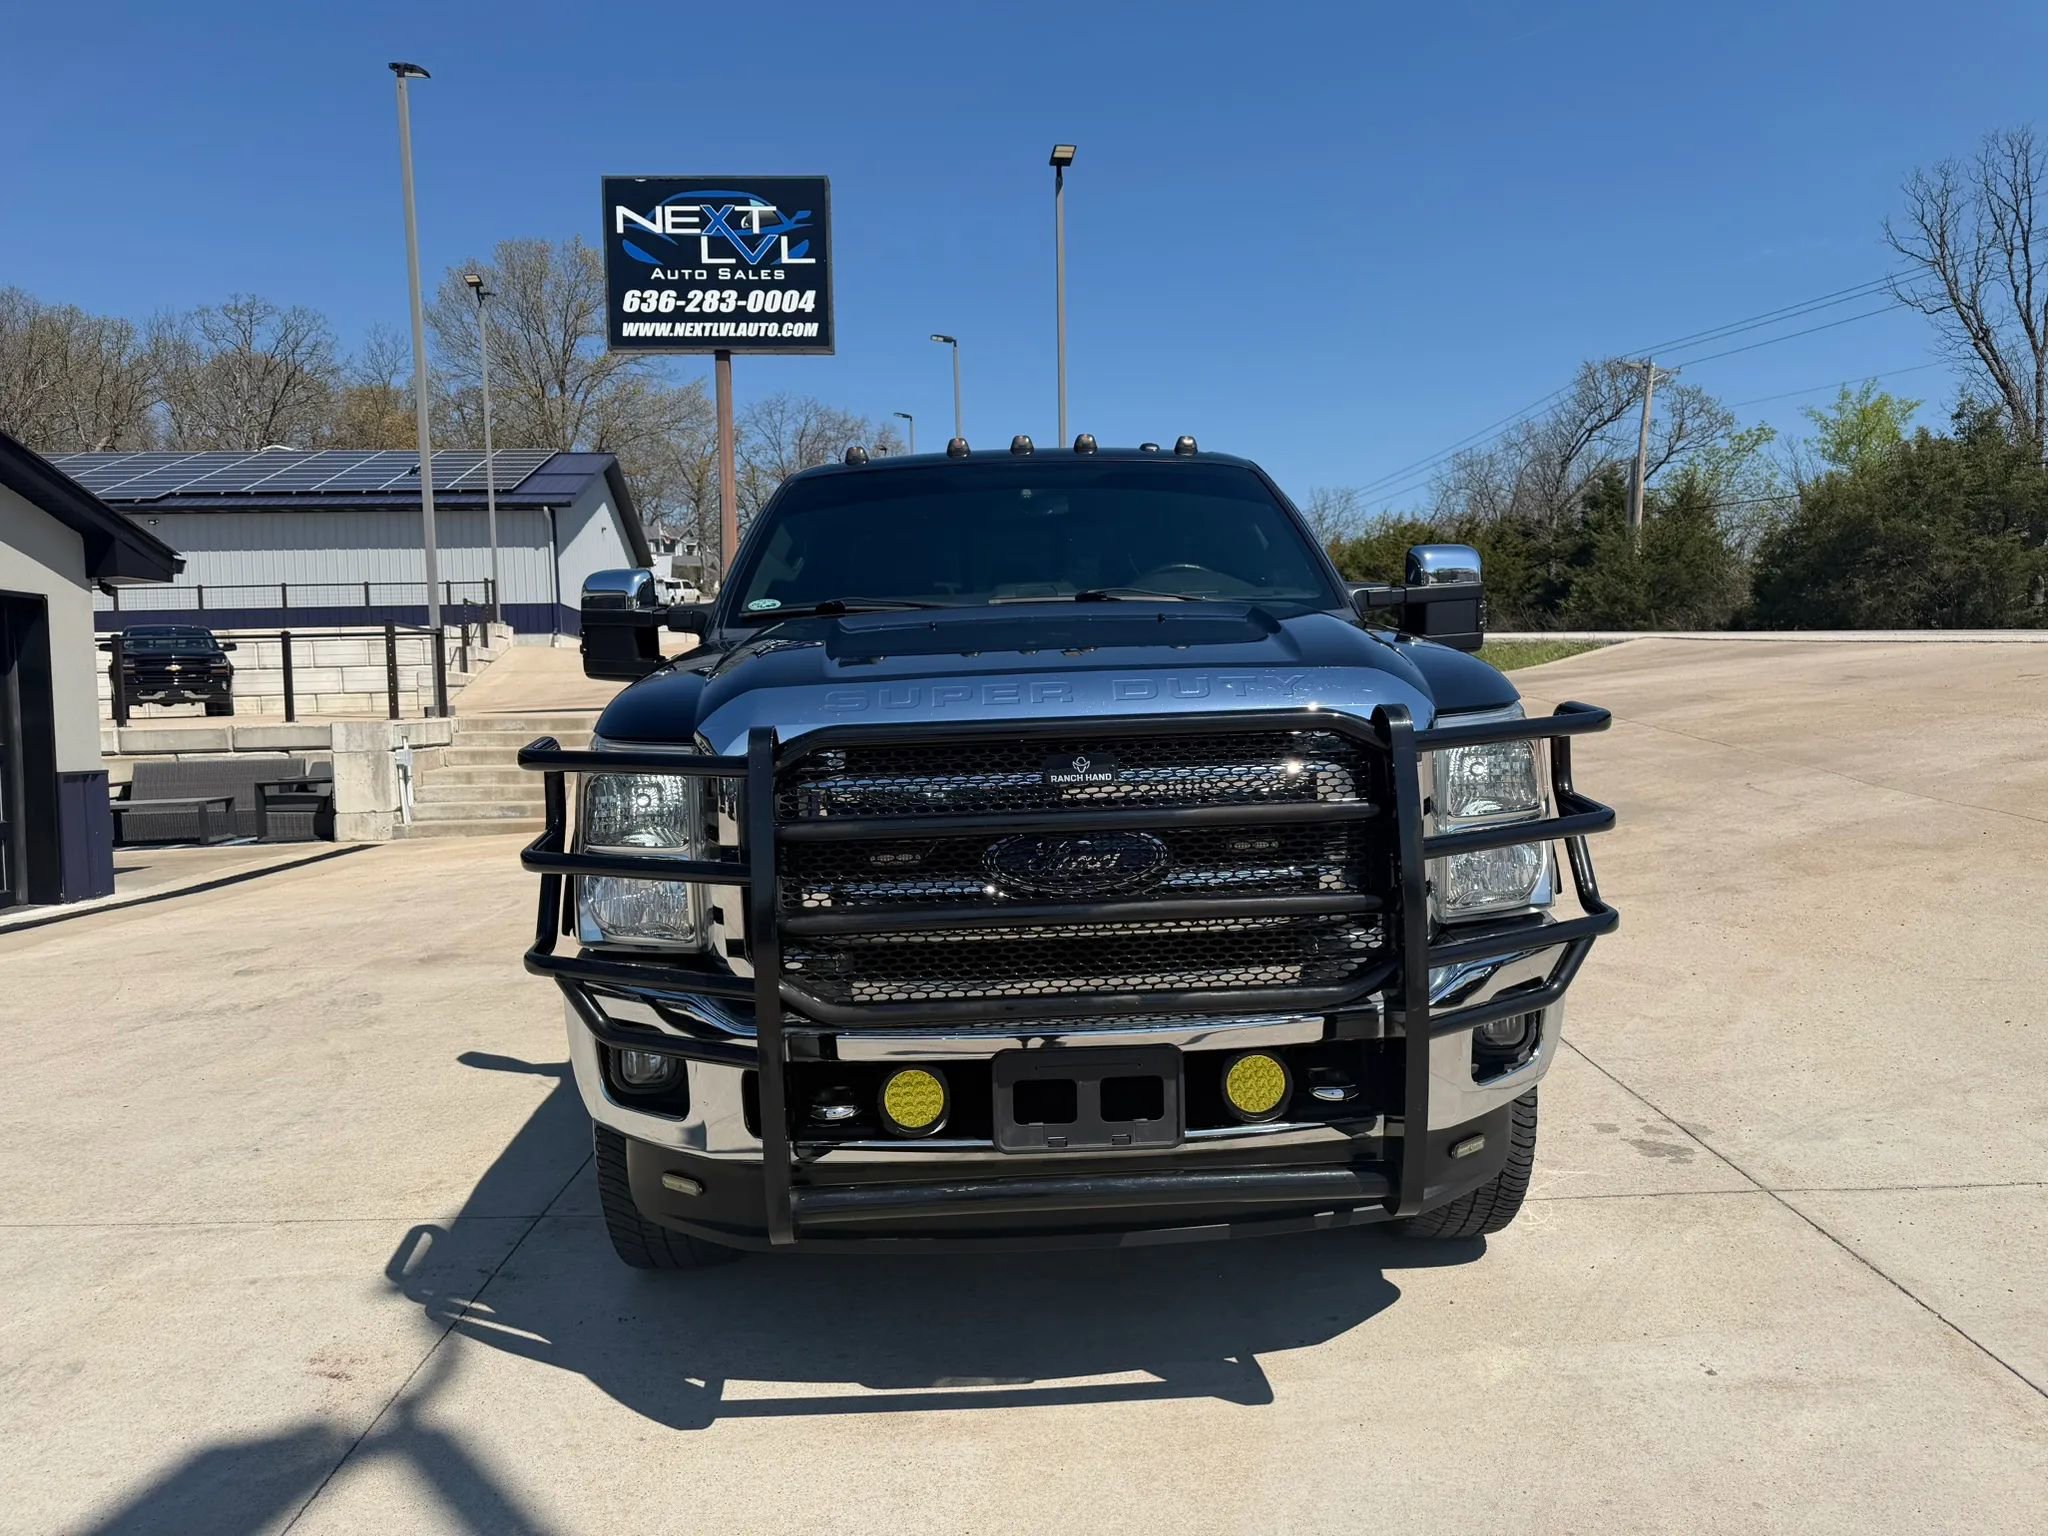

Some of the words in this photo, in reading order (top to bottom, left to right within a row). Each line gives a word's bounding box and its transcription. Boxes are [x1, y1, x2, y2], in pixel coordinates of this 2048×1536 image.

[616, 204, 777, 234] NEXT
[701, 234, 816, 265] LVL
[622, 289, 816, 313] 636-283-0004
[622, 322, 819, 337] WWW.NEXTLVLAUTO.COM
[824, 681, 1075, 713] SUPER
[1112, 674, 1305, 701] DUTY
[1050, 774, 1084, 783] RANCH
[1085, 773, 1112, 781] HAND
